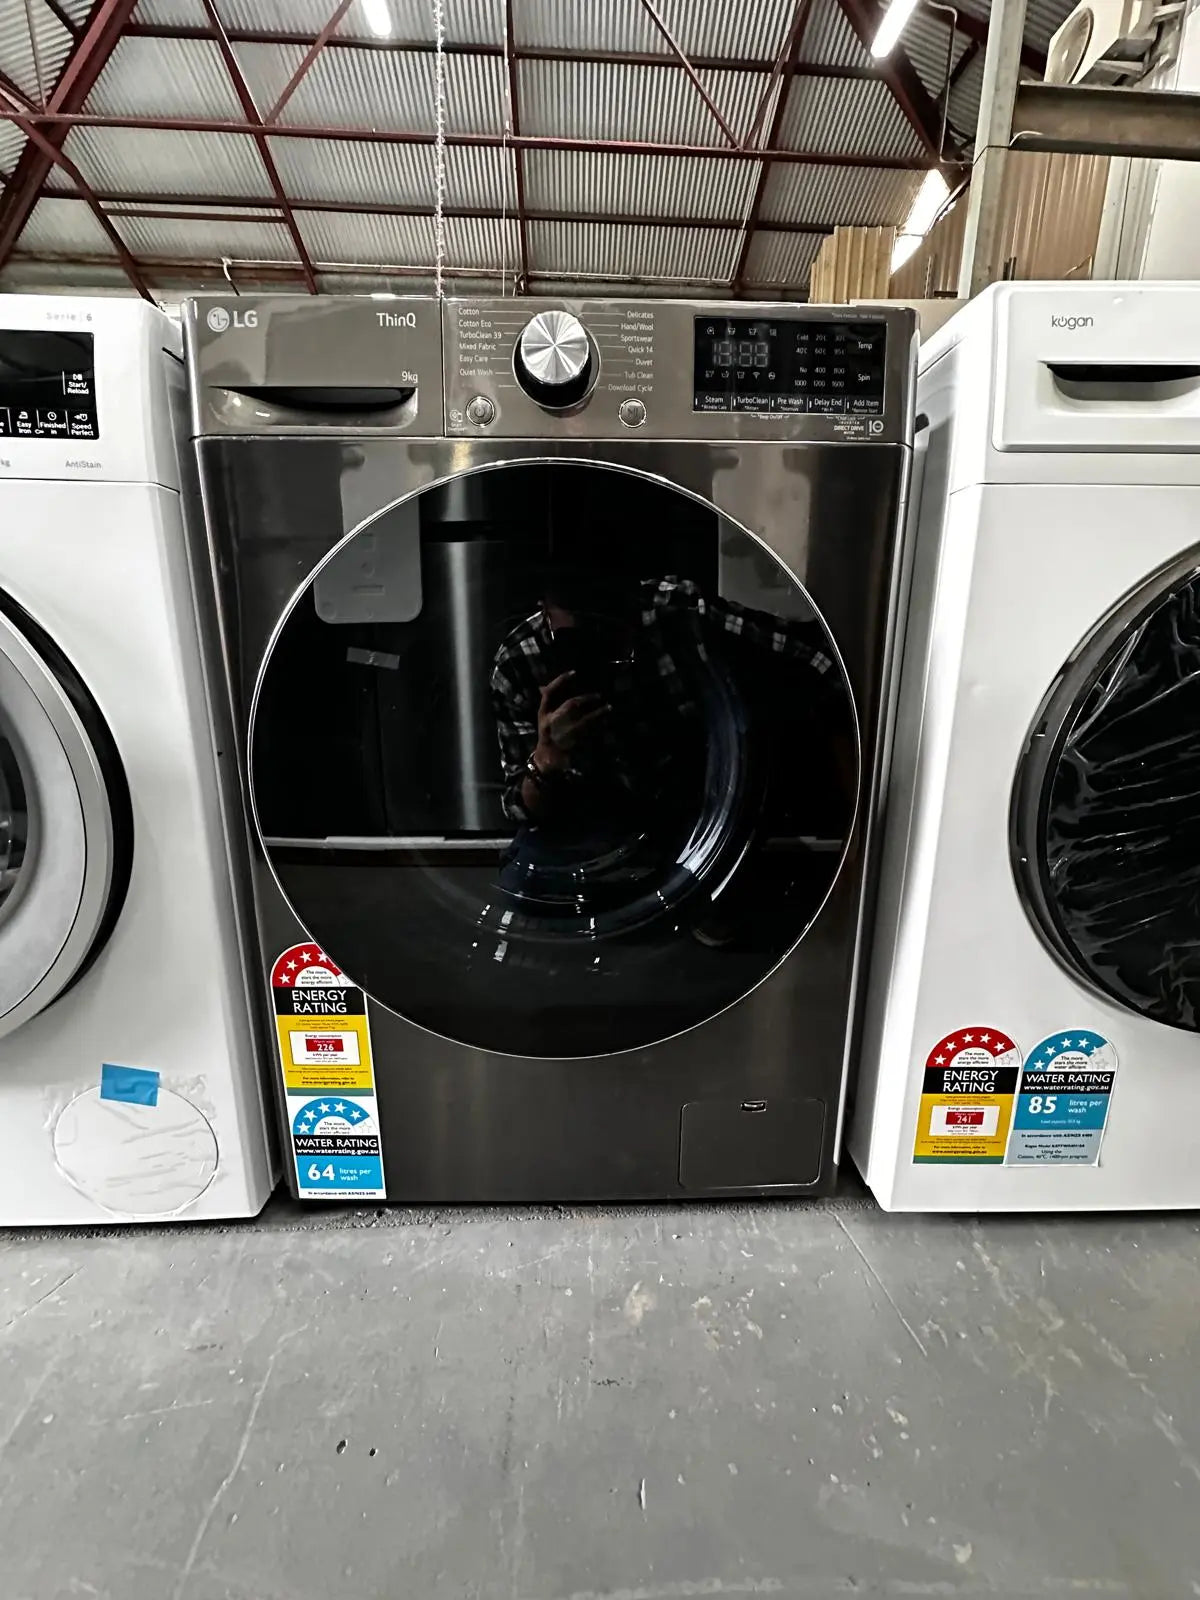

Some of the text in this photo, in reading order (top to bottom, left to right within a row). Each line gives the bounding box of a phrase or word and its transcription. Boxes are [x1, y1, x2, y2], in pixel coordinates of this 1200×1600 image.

[458, 307, 480, 315] Cotton
[627, 310, 654, 319] Delicates
[86, 313, 92, 322] 6
[233, 312, 258, 328] LG
[376, 312, 416, 329] ThinQ
[458, 319, 492, 328] Cotton Eco
[620, 323, 654, 331] Hand/Wool
[1051, 315, 1094, 330] kogan
[459, 331, 502, 339] TurboClean 39
[620, 334, 654, 342] Sportswear
[459, 342, 496, 351] Mixed Fabric
[627, 345, 645, 353] Quick
[858, 341, 873, 350] Temp
[459, 355, 473, 364] Easy
[401, 371, 418, 384] 9kg
[858, 373, 871, 381] Spin
[637, 384, 653, 393] Cycle
[705, 395, 724, 403] Steam
[777, 397, 787, 405] Pre
[814, 398, 842, 406] Delay End
[17, 421, 32, 429] Easy
[72, 423, 92, 431] Speed
[868, 420, 884, 433] 10
[71, 429, 94, 437] Perfect
[65, 460, 102, 470] AntiStain
[291, 990, 347, 1001] ENERGY
[293, 1002, 347, 1013] RATING
[317, 1043, 334, 1051] 226
[943, 1070, 999, 1081] ENERGY
[1026, 1074, 1111, 1083] WATER RATING
[943, 1082, 995, 1093] RATING
[1028, 1096, 1058, 1114] 85
[1069, 1099, 1103, 1108] litres per
[957, 1115, 971, 1124] 241
[296, 1138, 378, 1148] WATER RATING
[308, 1163, 335, 1181] 64
[339, 1167, 358, 1175] litres
